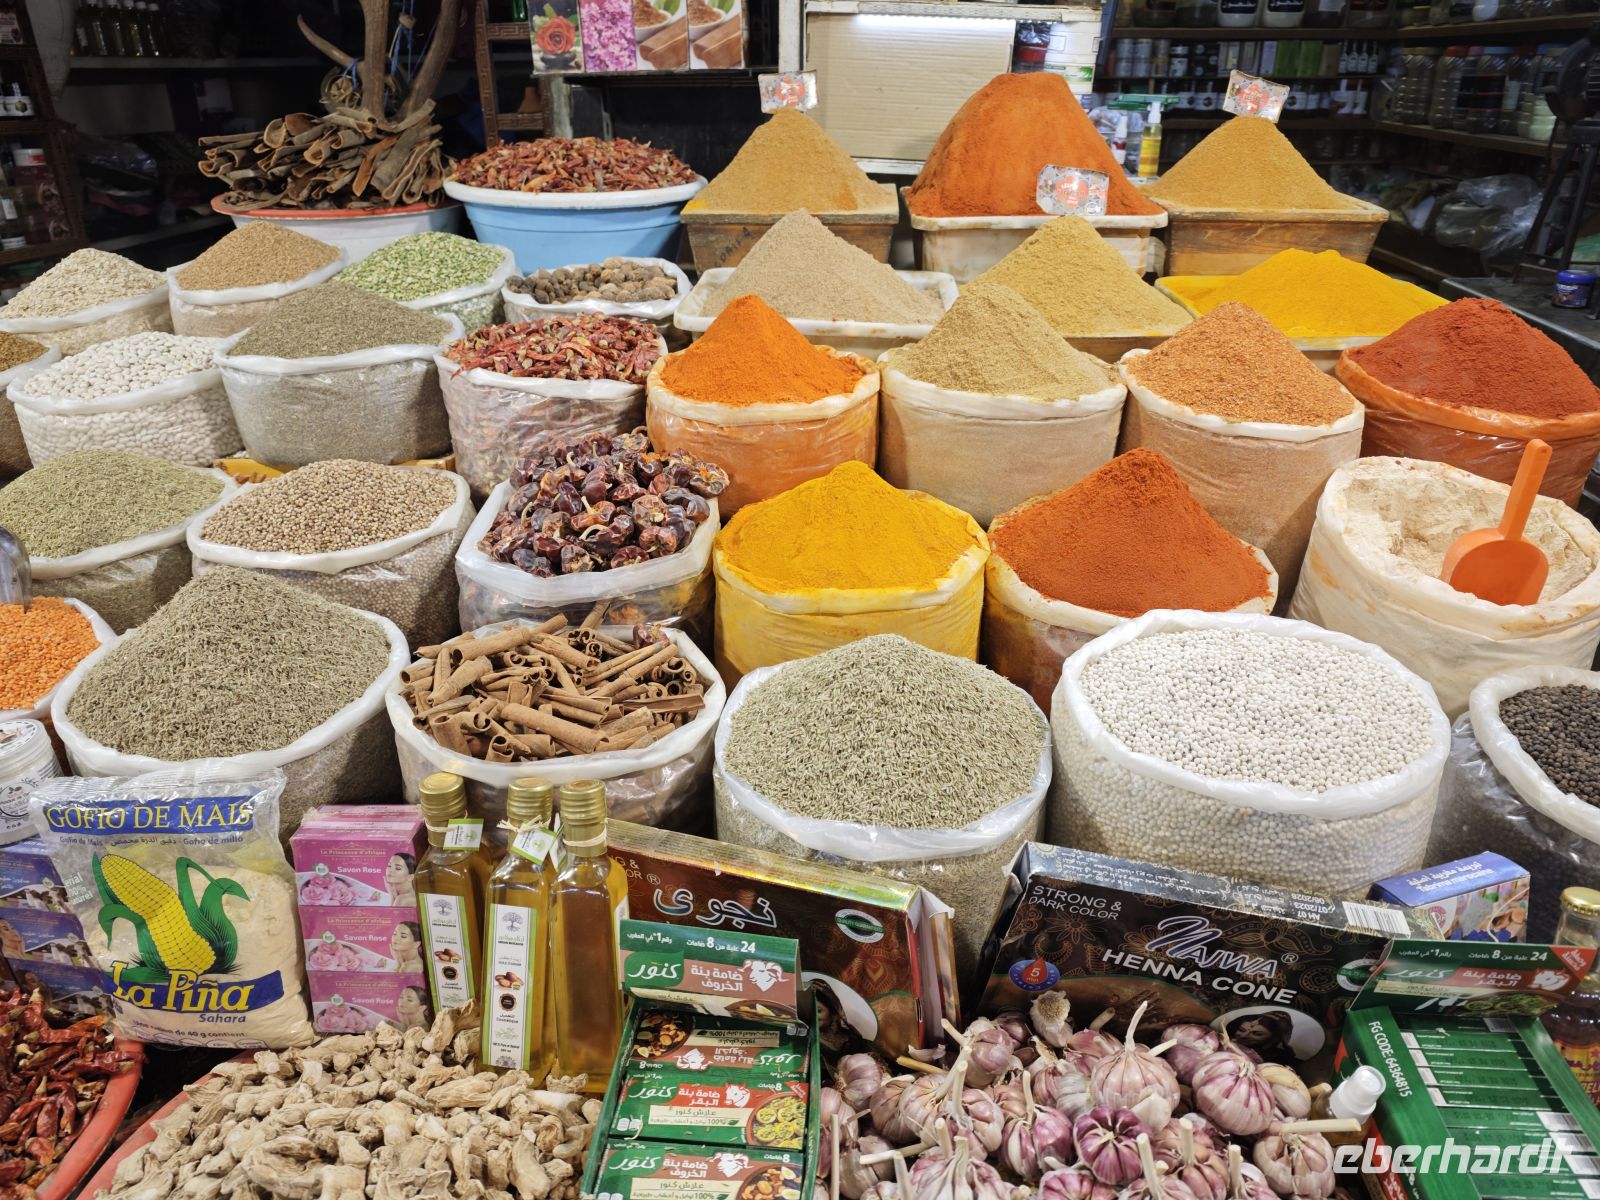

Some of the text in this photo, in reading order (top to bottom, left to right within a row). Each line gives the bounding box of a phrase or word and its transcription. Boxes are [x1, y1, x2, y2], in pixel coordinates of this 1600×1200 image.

[46, 804, 126, 830] GOFIO
[133, 805, 171, 829] DE
[337, 866, 382, 874] Savon Rose
[1031, 884, 1123, 912] STRONG &
[653, 888, 778, 930] نجوى
[1028, 896, 1120, 921] DARK COLOR
[343, 934, 388, 942] Savon Rose
[706, 936, 714, 949] 8
[740, 940, 756, 954] 24
[1145, 915, 1278, 979] NAJWA
[1491, 950, 1501, 960] 8
[1529, 951, 1548, 961] 24
[627, 961, 682, 980] كنور
[1030, 967, 1041, 977] 5
[1101, 948, 1203, 986] HENNA
[1211, 976, 1298, 1005] CONE
[110, 959, 255, 1013] La Piña
[701, 978, 744, 992] الخروف
[351, 997, 394, 1006] Savon Rose
[199, 1012, 246, 1024] Sahara
[1368, 1020, 1413, 1098] FG CODE: 64364815
[629, 1084, 677, 1099] كنور
[609, 1155, 661, 1171] كنور
[670, 1169, 707, 1179] الخروف
